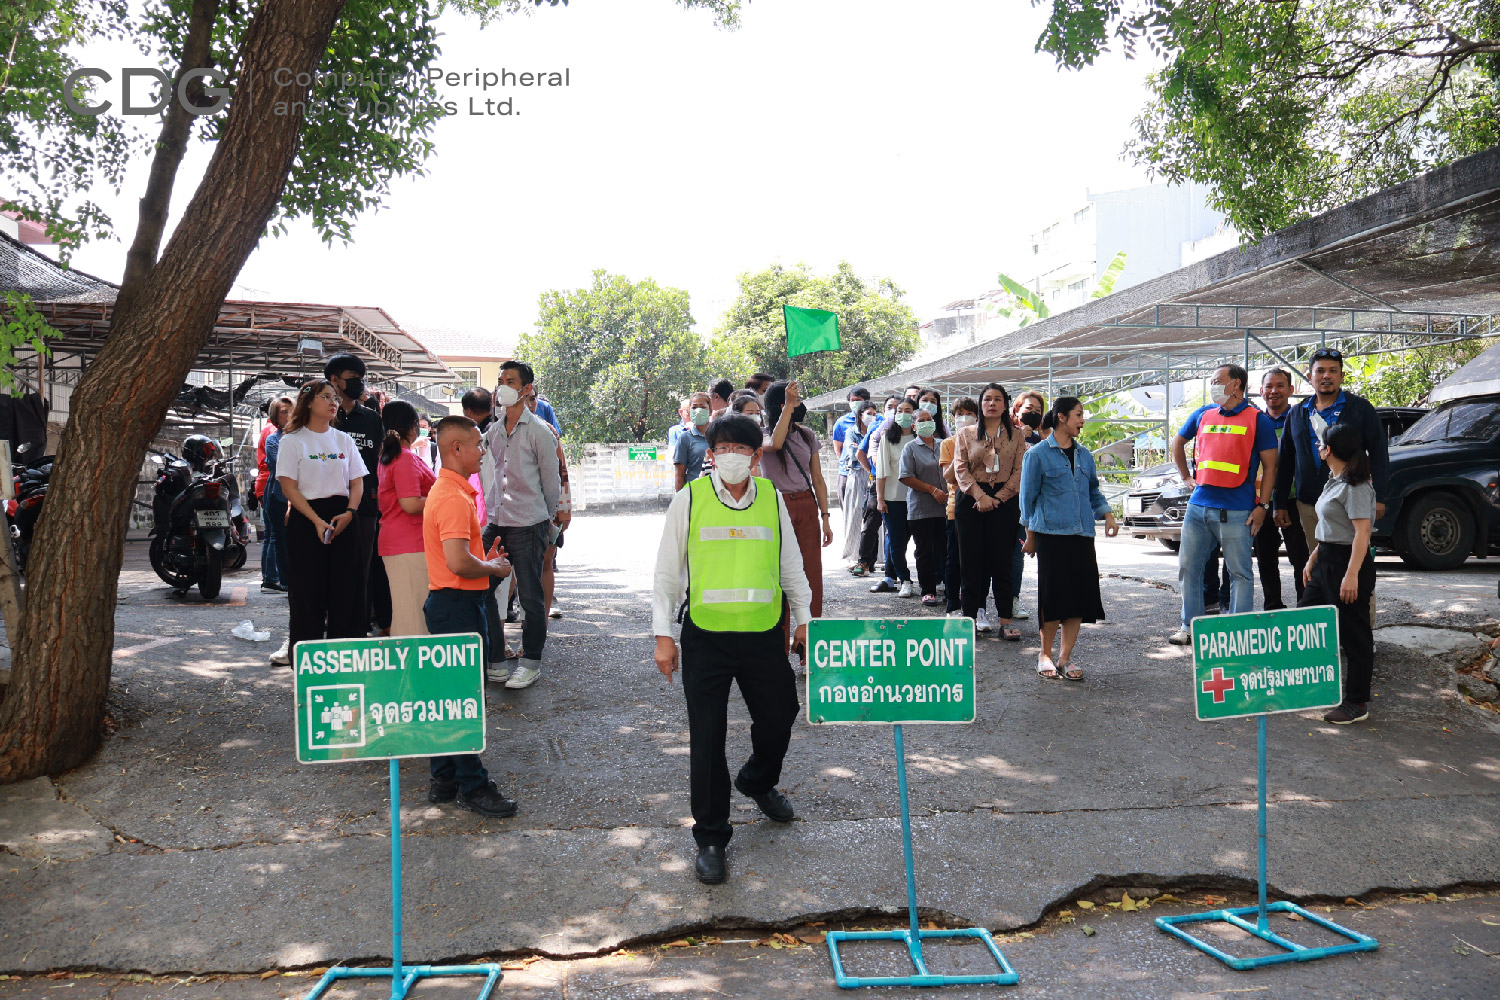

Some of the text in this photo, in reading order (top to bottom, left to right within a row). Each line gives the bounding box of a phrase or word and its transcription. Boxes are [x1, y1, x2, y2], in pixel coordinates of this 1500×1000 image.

[814, 637, 968, 668] CENTER POINT
[1199, 622, 1328, 660] PARAMEDIC POINT
[299, 643, 479, 675] ASSEMBLY POINT
[819, 675, 964, 703] กองอำนวยการ
[1239, 664, 1335, 700] จุดปฐมพยาบาล
[369, 697, 478, 737] จุดรวมพล
